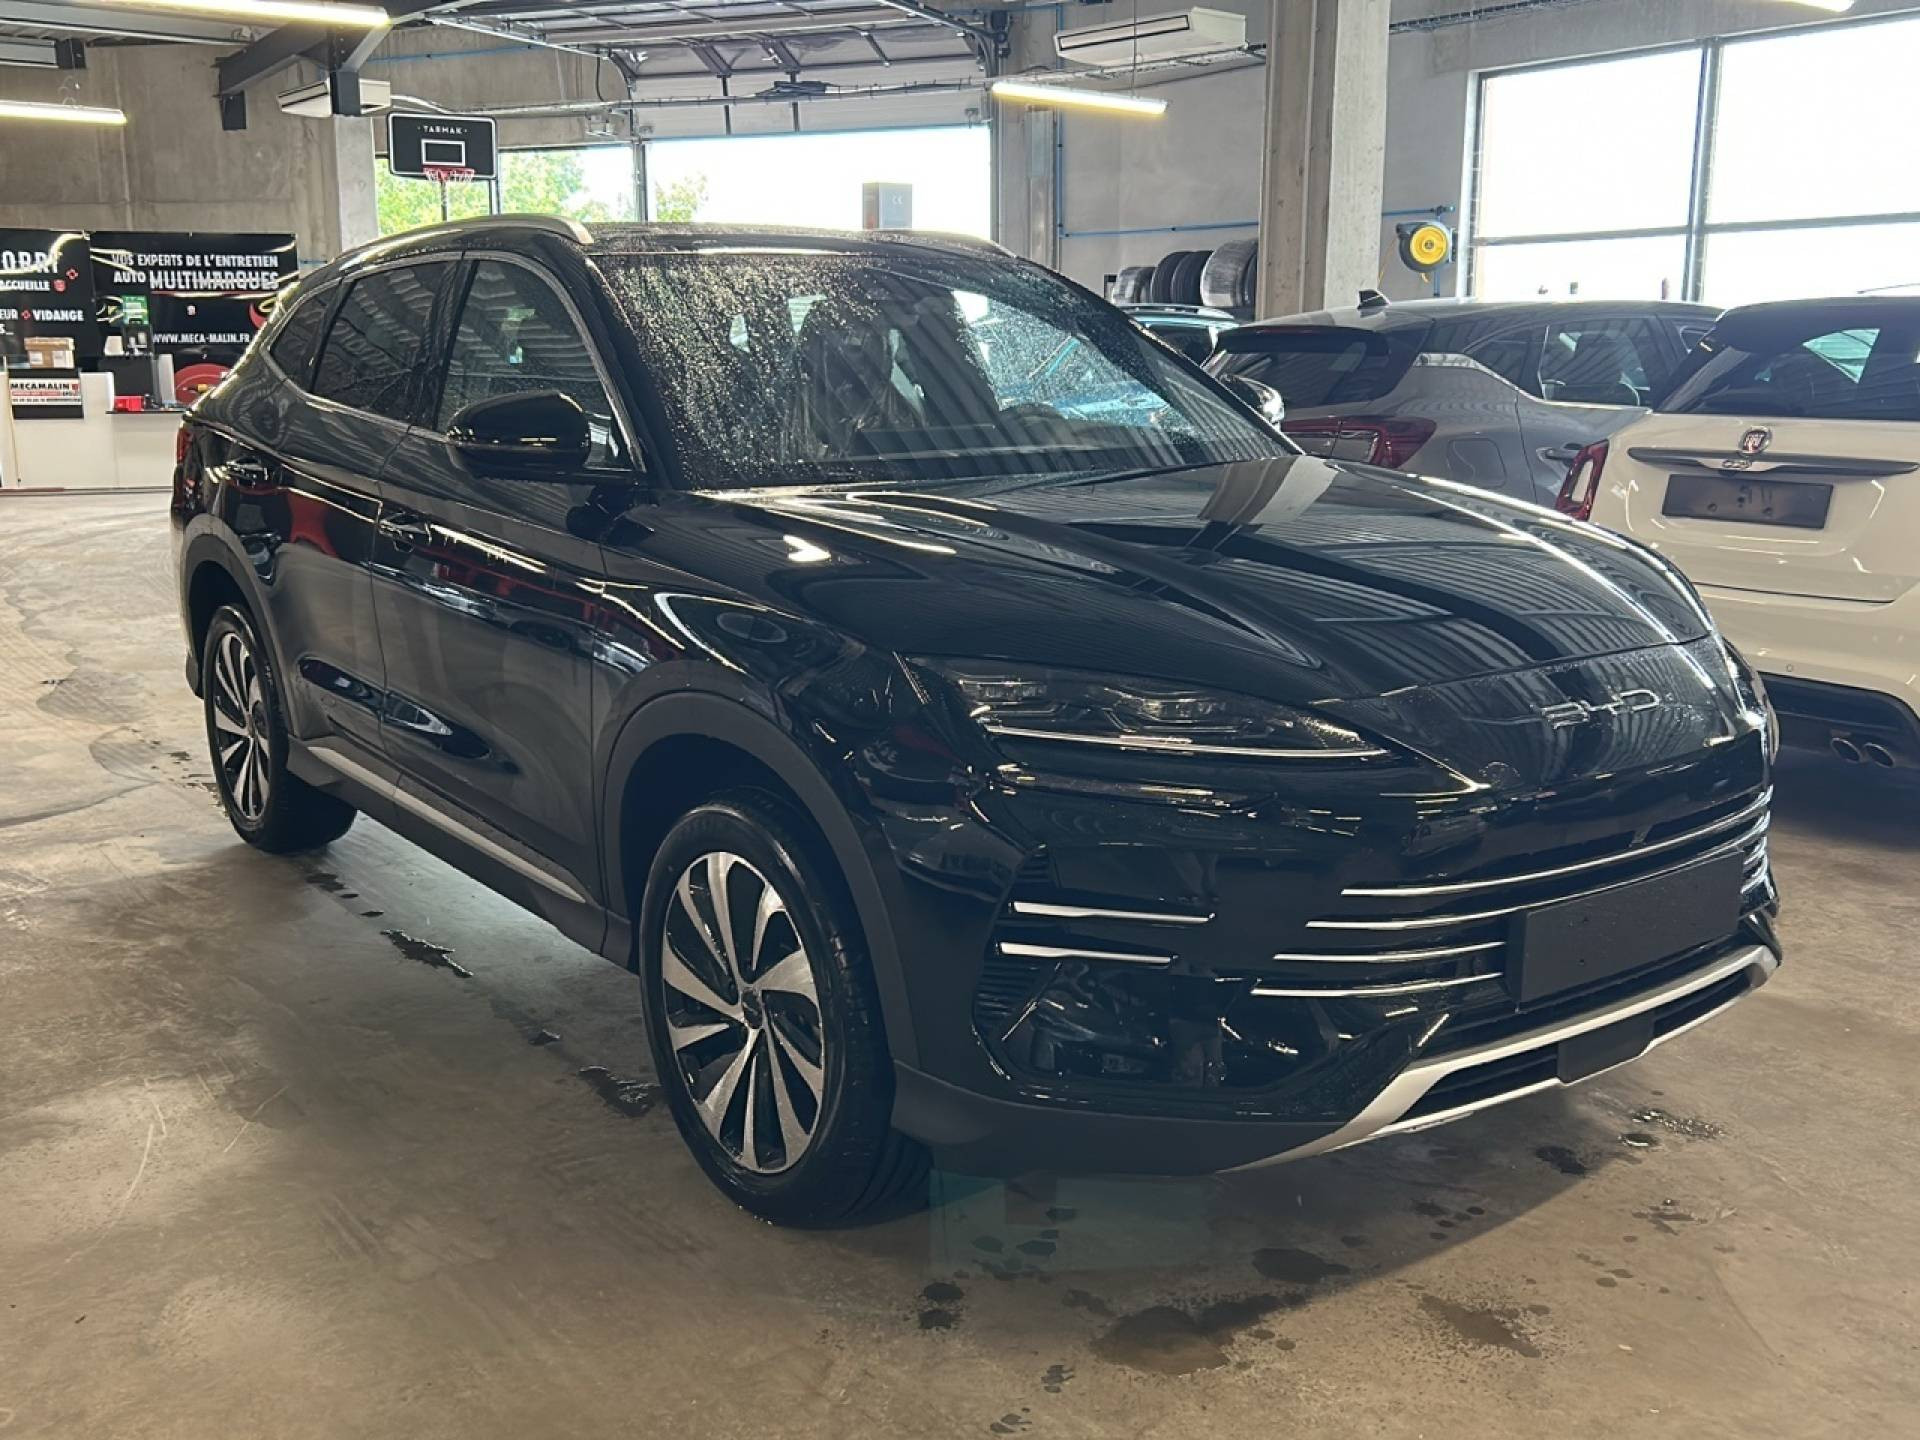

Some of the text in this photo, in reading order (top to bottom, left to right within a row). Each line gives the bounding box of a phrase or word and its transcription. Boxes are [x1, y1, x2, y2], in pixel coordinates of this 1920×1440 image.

[137, 254, 183, 267] EXPERTS
[185, 254, 201, 267] DE
[203, 254, 279, 268] L'ENTRETIEN
[113, 270, 280, 291] AUTO MULTIMARQUES
[32, 309, 84, 322] VIDANGE
[152, 332, 250, 343] WWW.MECA-MALIN.FR
